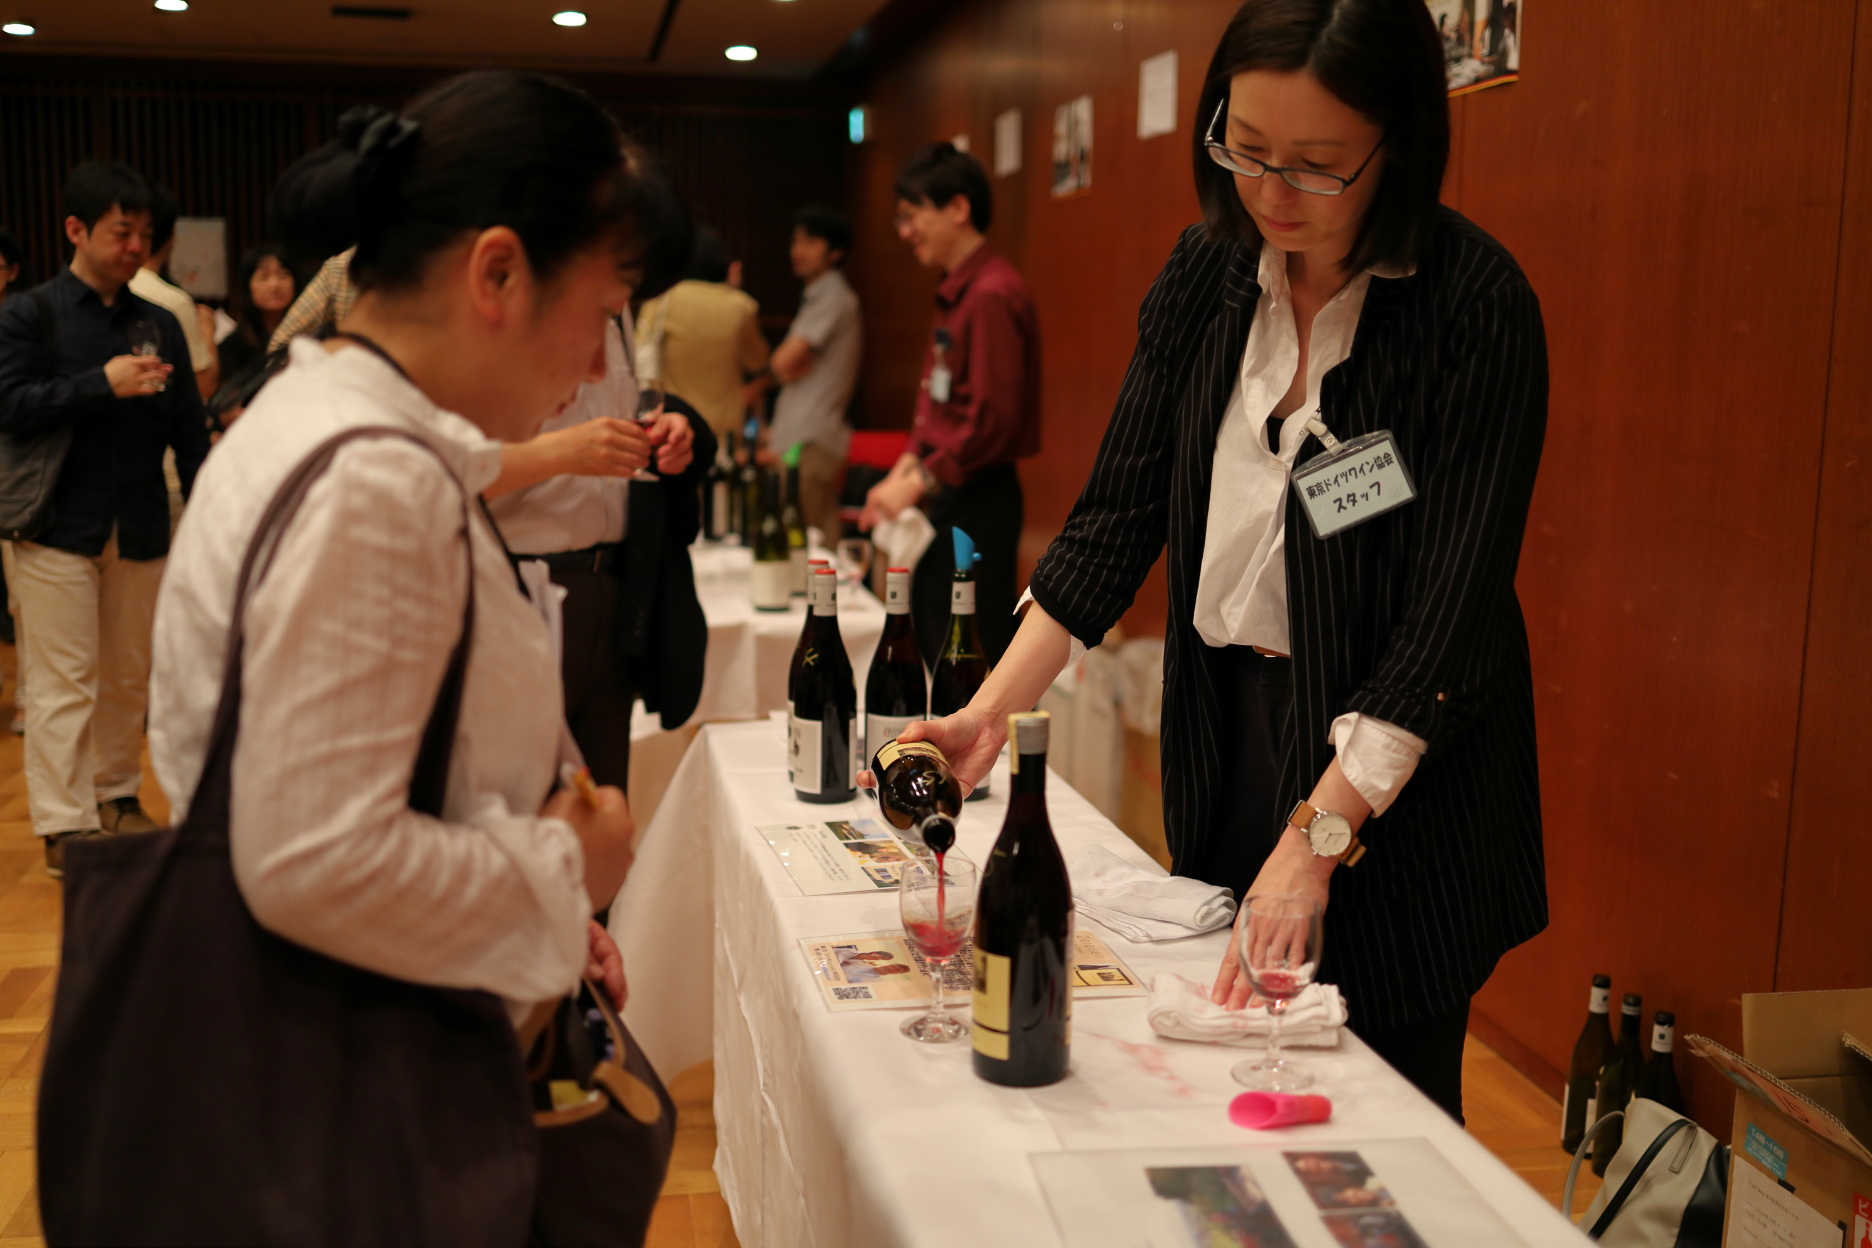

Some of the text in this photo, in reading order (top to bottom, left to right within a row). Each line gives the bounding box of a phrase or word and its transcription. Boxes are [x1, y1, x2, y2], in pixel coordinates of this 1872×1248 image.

[1305, 452, 1394, 500] 東京ドイツワイン協会
[1333, 481, 1381, 513] スタッフ
